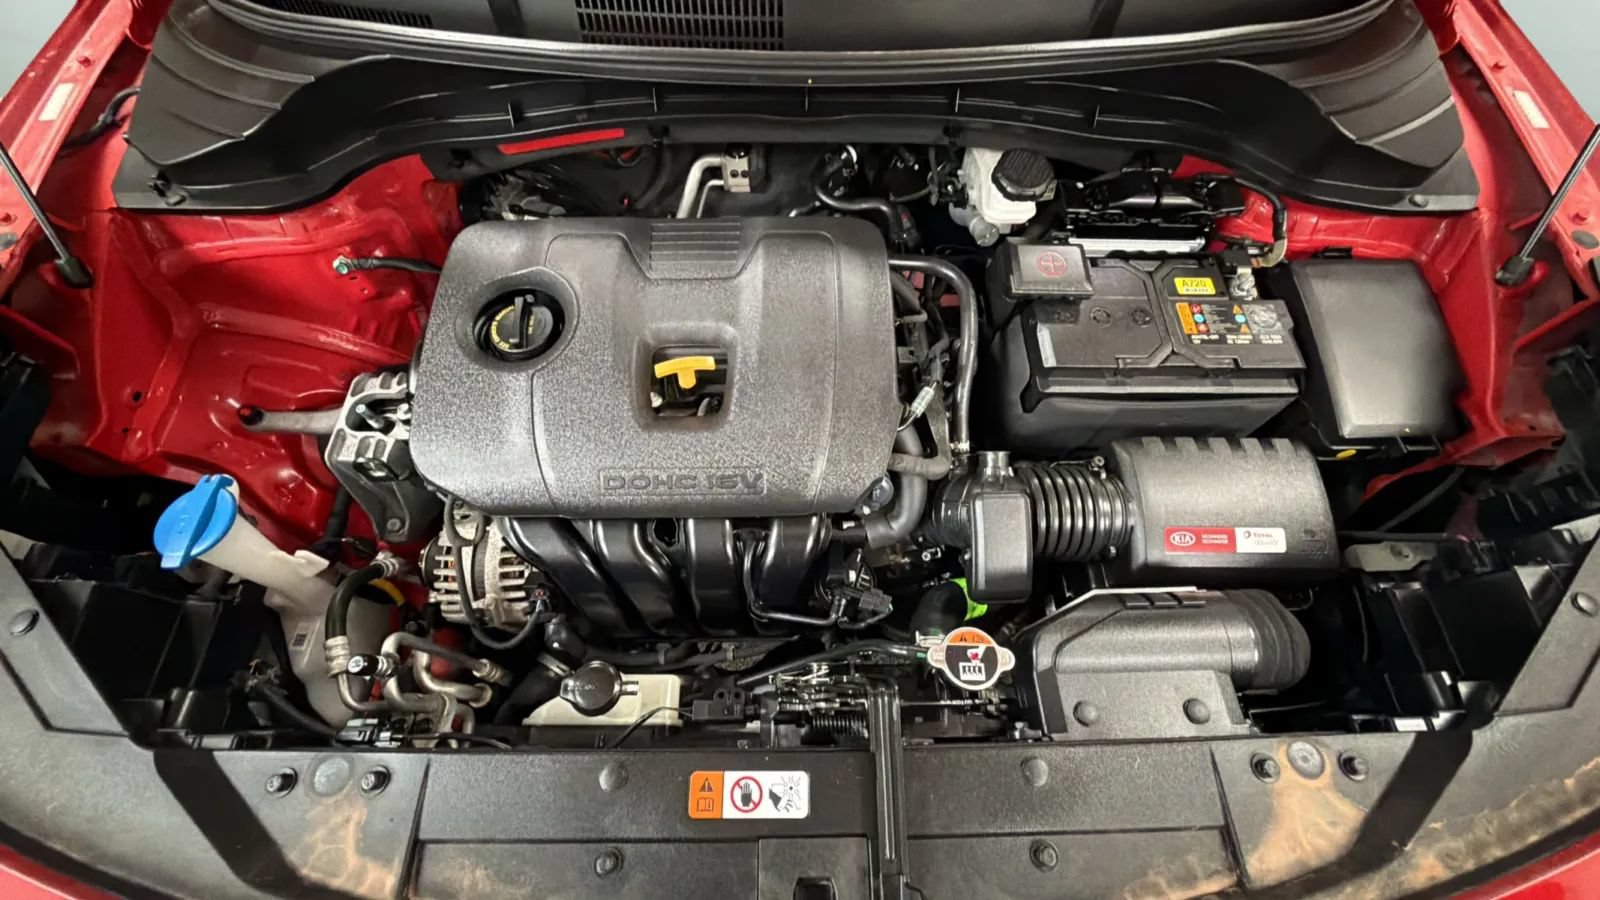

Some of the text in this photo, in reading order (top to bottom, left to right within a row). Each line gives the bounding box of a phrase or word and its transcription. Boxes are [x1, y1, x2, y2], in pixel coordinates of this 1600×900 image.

[604, 472, 765, 490] DOHC 16V
[1173, 533, 1193, 544] KIA
